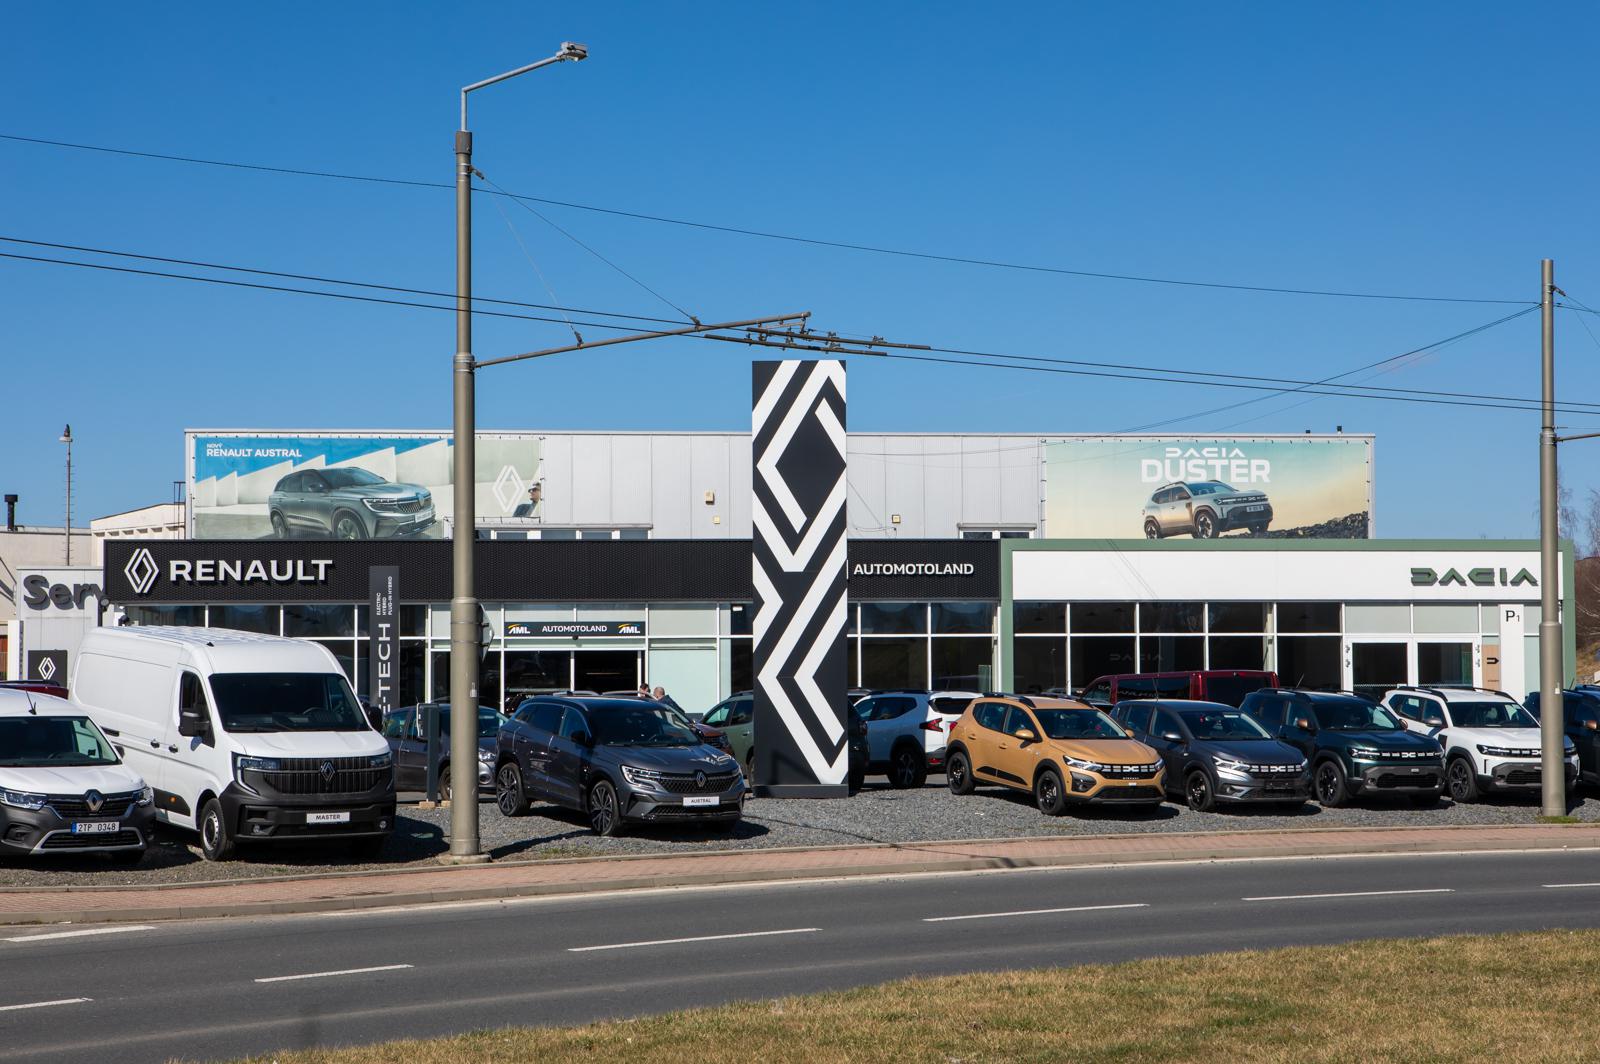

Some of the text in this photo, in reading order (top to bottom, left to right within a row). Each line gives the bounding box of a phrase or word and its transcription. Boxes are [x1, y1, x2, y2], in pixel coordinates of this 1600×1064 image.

[206, 448, 302, 457] RENAULT AUSTRAL
[1165, 447, 1246, 458] DACIA
[1141, 459, 1271, 483] DUSTER
[169, 559, 333, 582] RENAULT
[853, 563, 975, 575] AUTOMOTOLAND
[1410, 567, 1539, 586] DACIA
[508, 624, 640, 634] AML AUTOMOTOLAND AML
[78, 822, 116, 832] 2TP 0348
